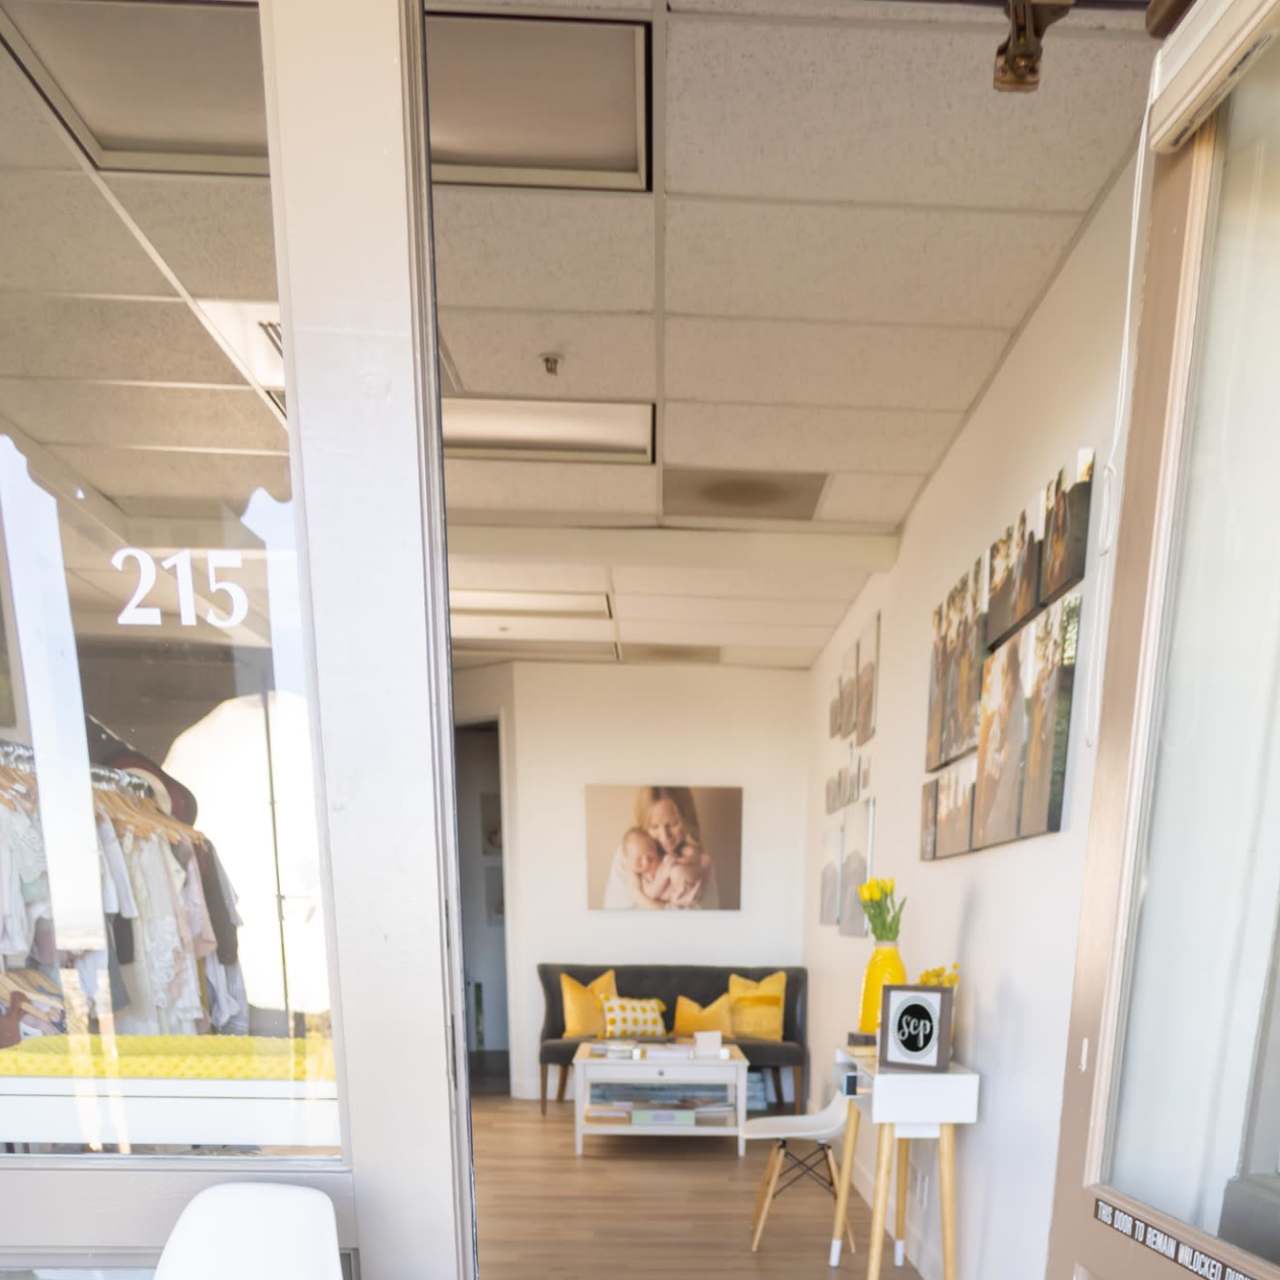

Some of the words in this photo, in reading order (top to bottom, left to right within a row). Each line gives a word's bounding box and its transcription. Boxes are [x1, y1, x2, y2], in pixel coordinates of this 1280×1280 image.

[111, 547, 249, 628] 215
[1134, 1219, 1145, 1242] TO
[1145, 1226, 1177, 1259] REMAIN
